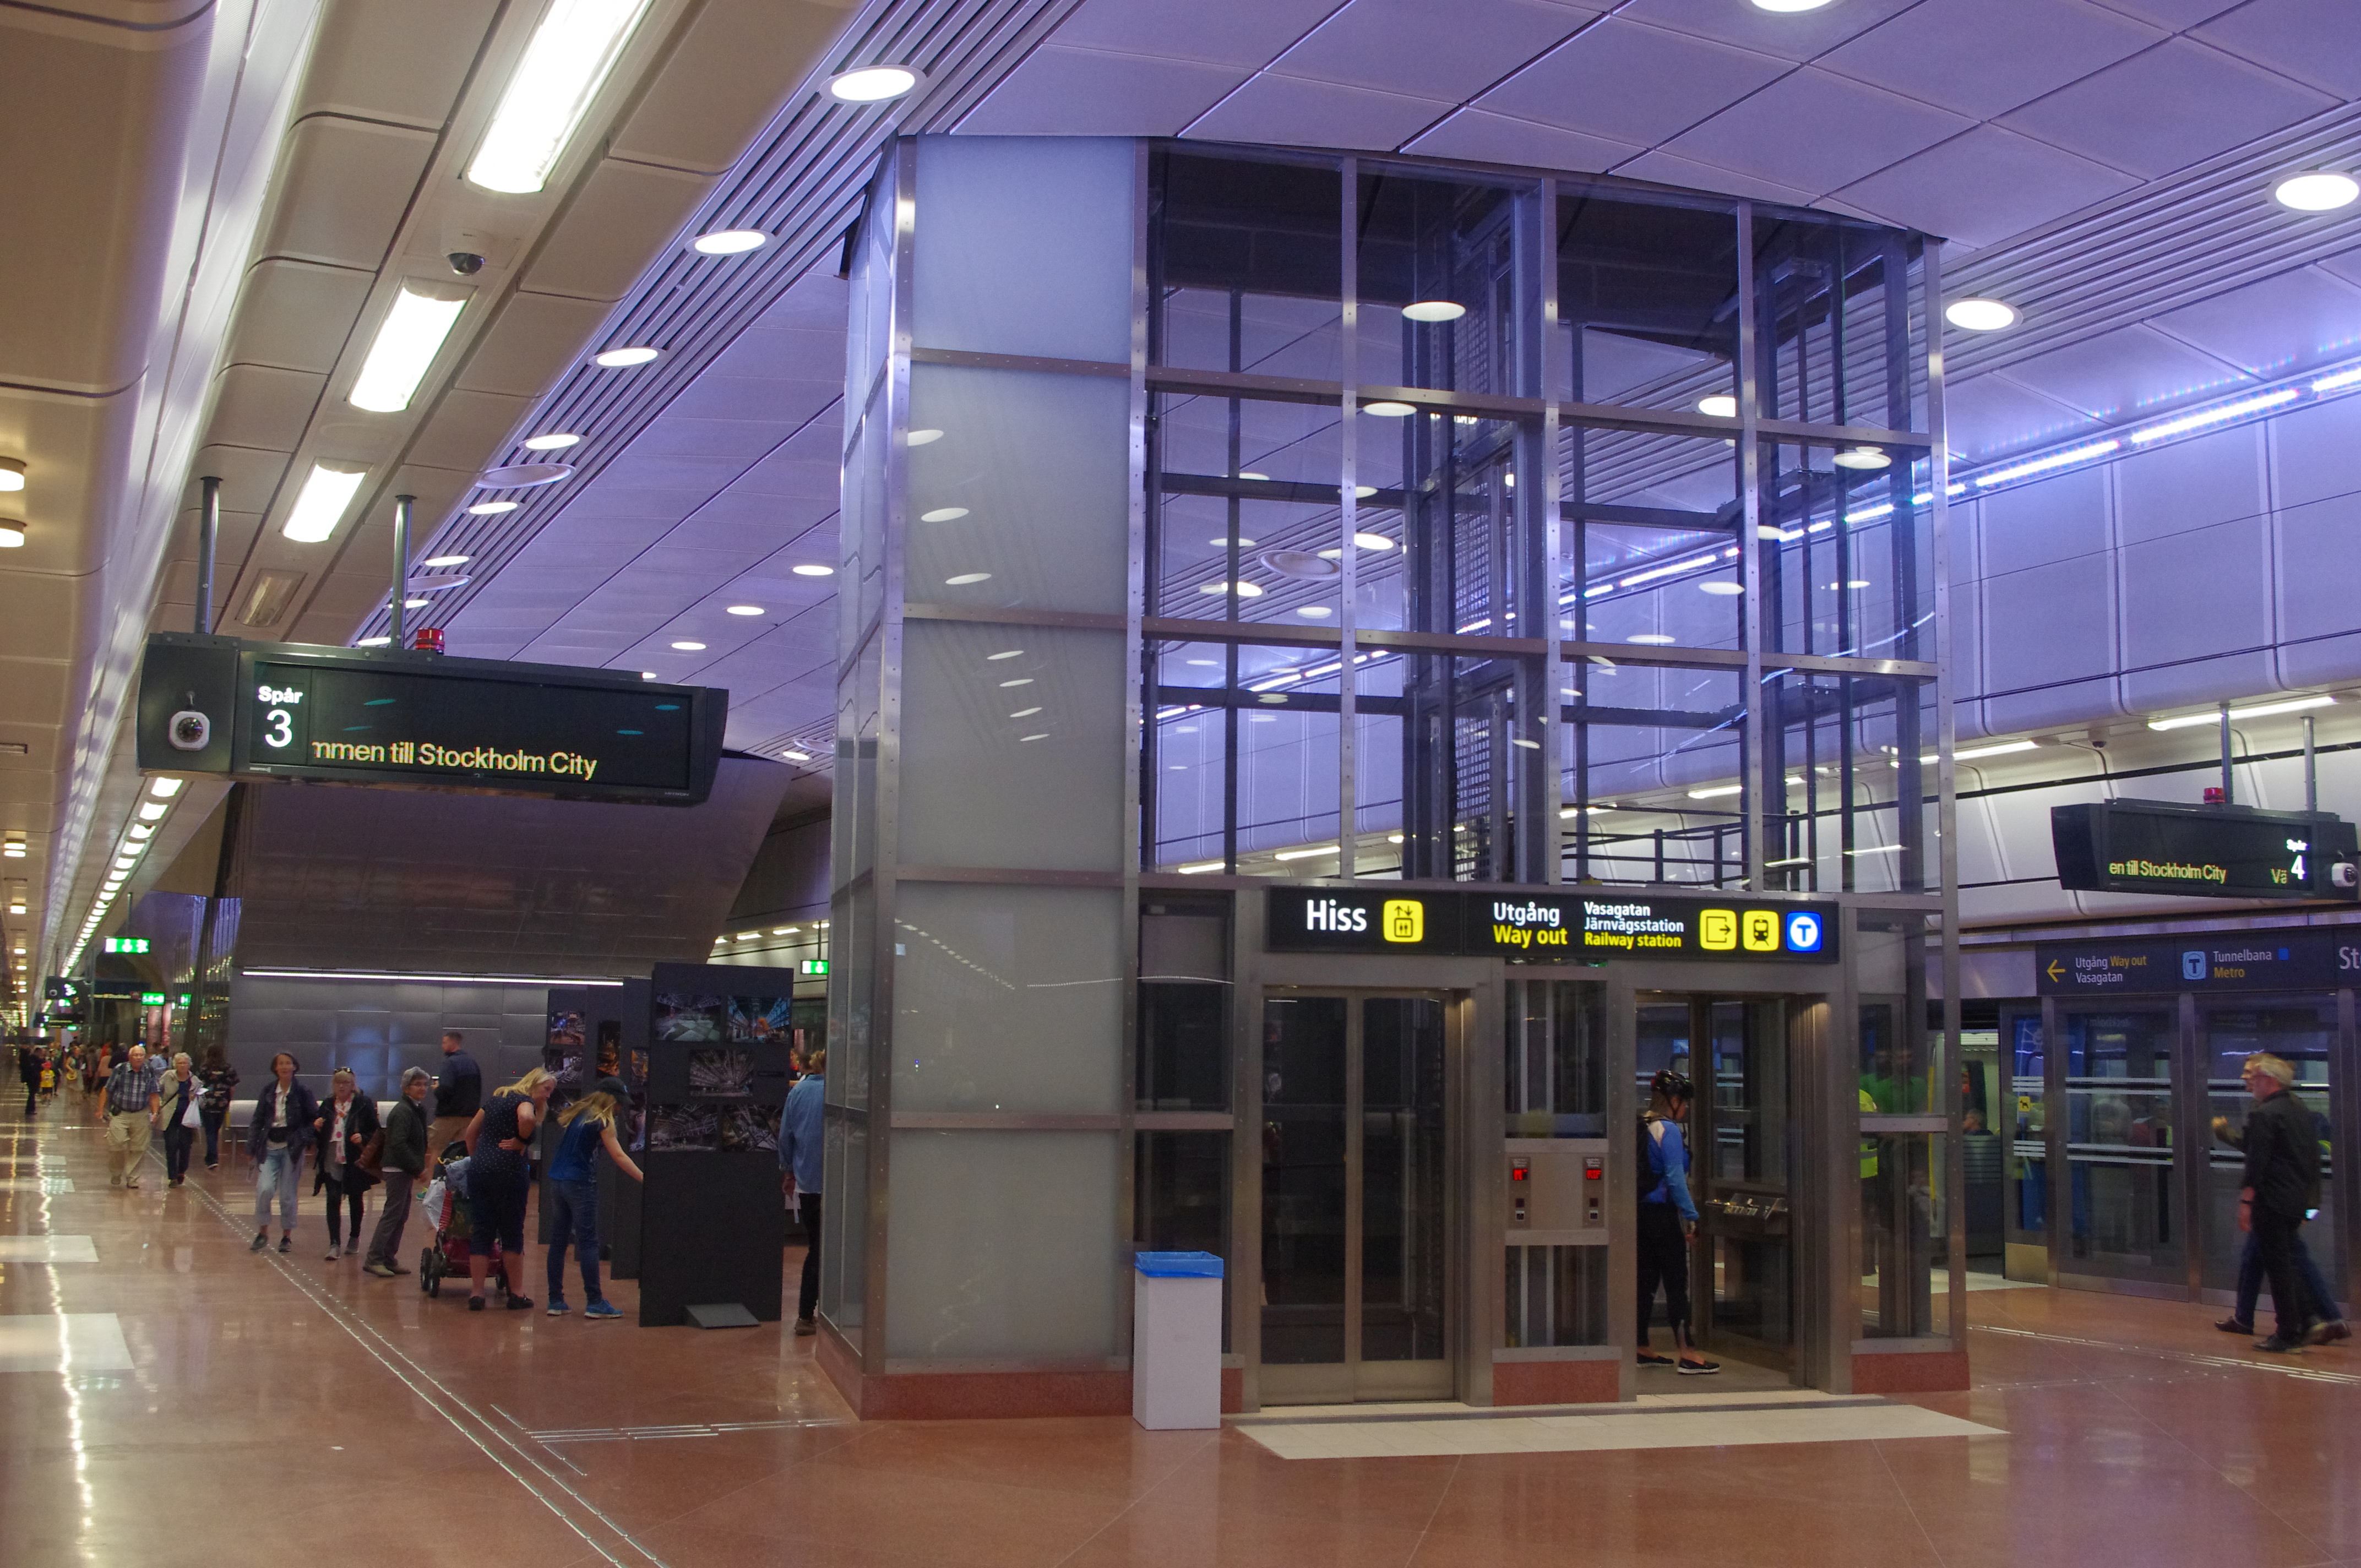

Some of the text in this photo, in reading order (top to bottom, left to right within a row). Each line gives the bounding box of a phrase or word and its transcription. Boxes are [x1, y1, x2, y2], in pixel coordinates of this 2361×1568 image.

[258, 686, 303, 705] Spår
[265, 709, 292, 747] 3
[389, 741, 414, 764] till
[418, 743, 546, 772] Stockholm
[549, 751, 597, 781] City
[2108, 862, 2125, 875] en
[2126, 860, 2139, 876] till
[2140, 859, 2202, 879] Stockholm
[2202, 864, 2227, 884] City
[2291, 854, 2305, 880] 4
[1307, 899, 1367, 932] Hiss
[1494, 901, 1560, 927] Utgång
[1584, 901, 1651, 919] Vasagatan
[1584, 917, 1684, 934] Järnvägsstation
[1797, 924, 1811, 942] T
[1493, 925, 1568, 949] Way out
[1585, 932, 1682, 950] Railway station
[2075, 955, 2147, 971] Utgång Way out
[2213, 949, 2272, 962] Tunnelbana
[2339, 946, 2361, 970] St
[2189, 959, 2200, 974] T
[2214, 967, 2245, 978] Metro
[2075, 972, 2123, 986] Vasagatan
